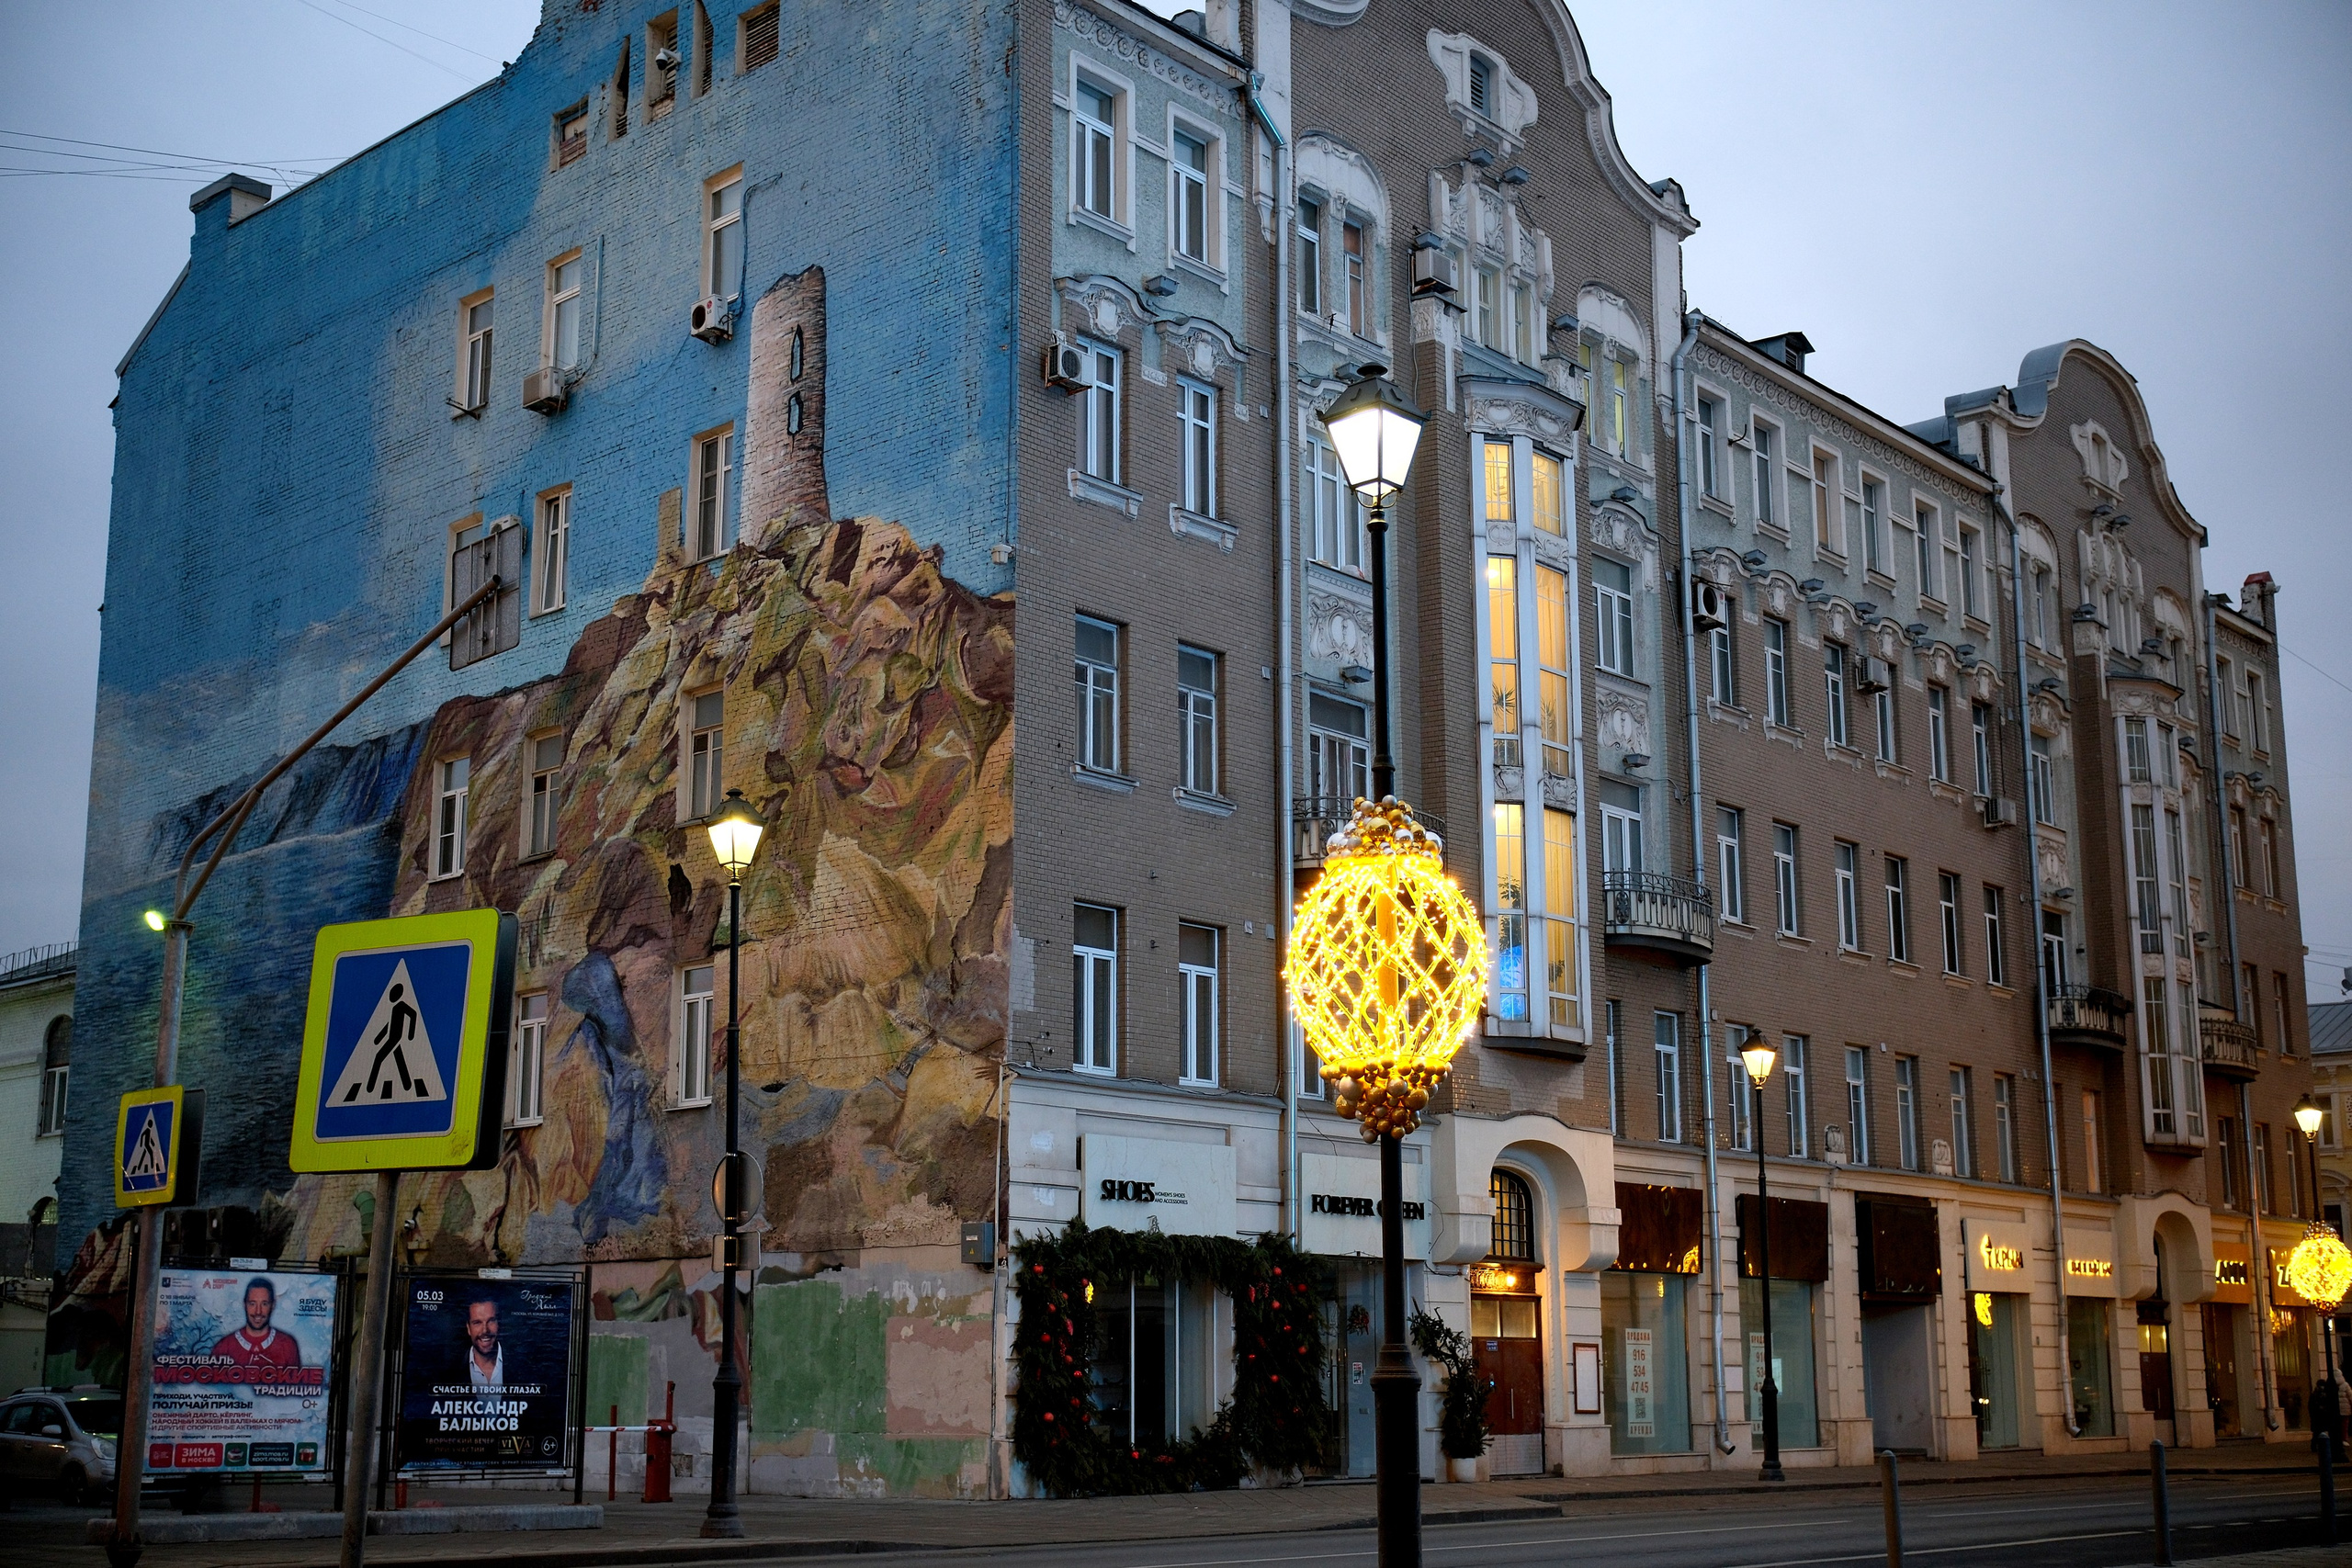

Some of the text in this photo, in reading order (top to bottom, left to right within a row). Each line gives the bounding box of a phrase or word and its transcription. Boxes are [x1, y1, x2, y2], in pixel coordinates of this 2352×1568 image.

[1100, 1179, 1155, 1202] SHOES
[1311, 1194, 1425, 1221] FOREVER EEN
[417, 1291, 444, 1301] 05.03
[156, 1355, 233, 1365] ФЕСТИВАЛЬ
[1633, 1349, 1645, 1361] 916
[153, 1365, 325, 1384] МОСКОВСКИЕ
[1634, 1365, 1645, 1377] 534
[254, 1385, 322, 1396] ТРАДИЦИИ
[433, 1385, 469, 1393] СЧАСТЬЕ
[509, 1386, 540, 1394] ГЛАЗАХ
[153, 1400, 209, 1409] ПОЛУЧАЙ
[431, 1401, 528, 1416] АЛЕКСАНДР
[439, 1418, 519, 1431] БАЛЫКОВ
[543, 1440, 557, 1450] 6+
[182, 1448, 216, 1457] ЗИМА
